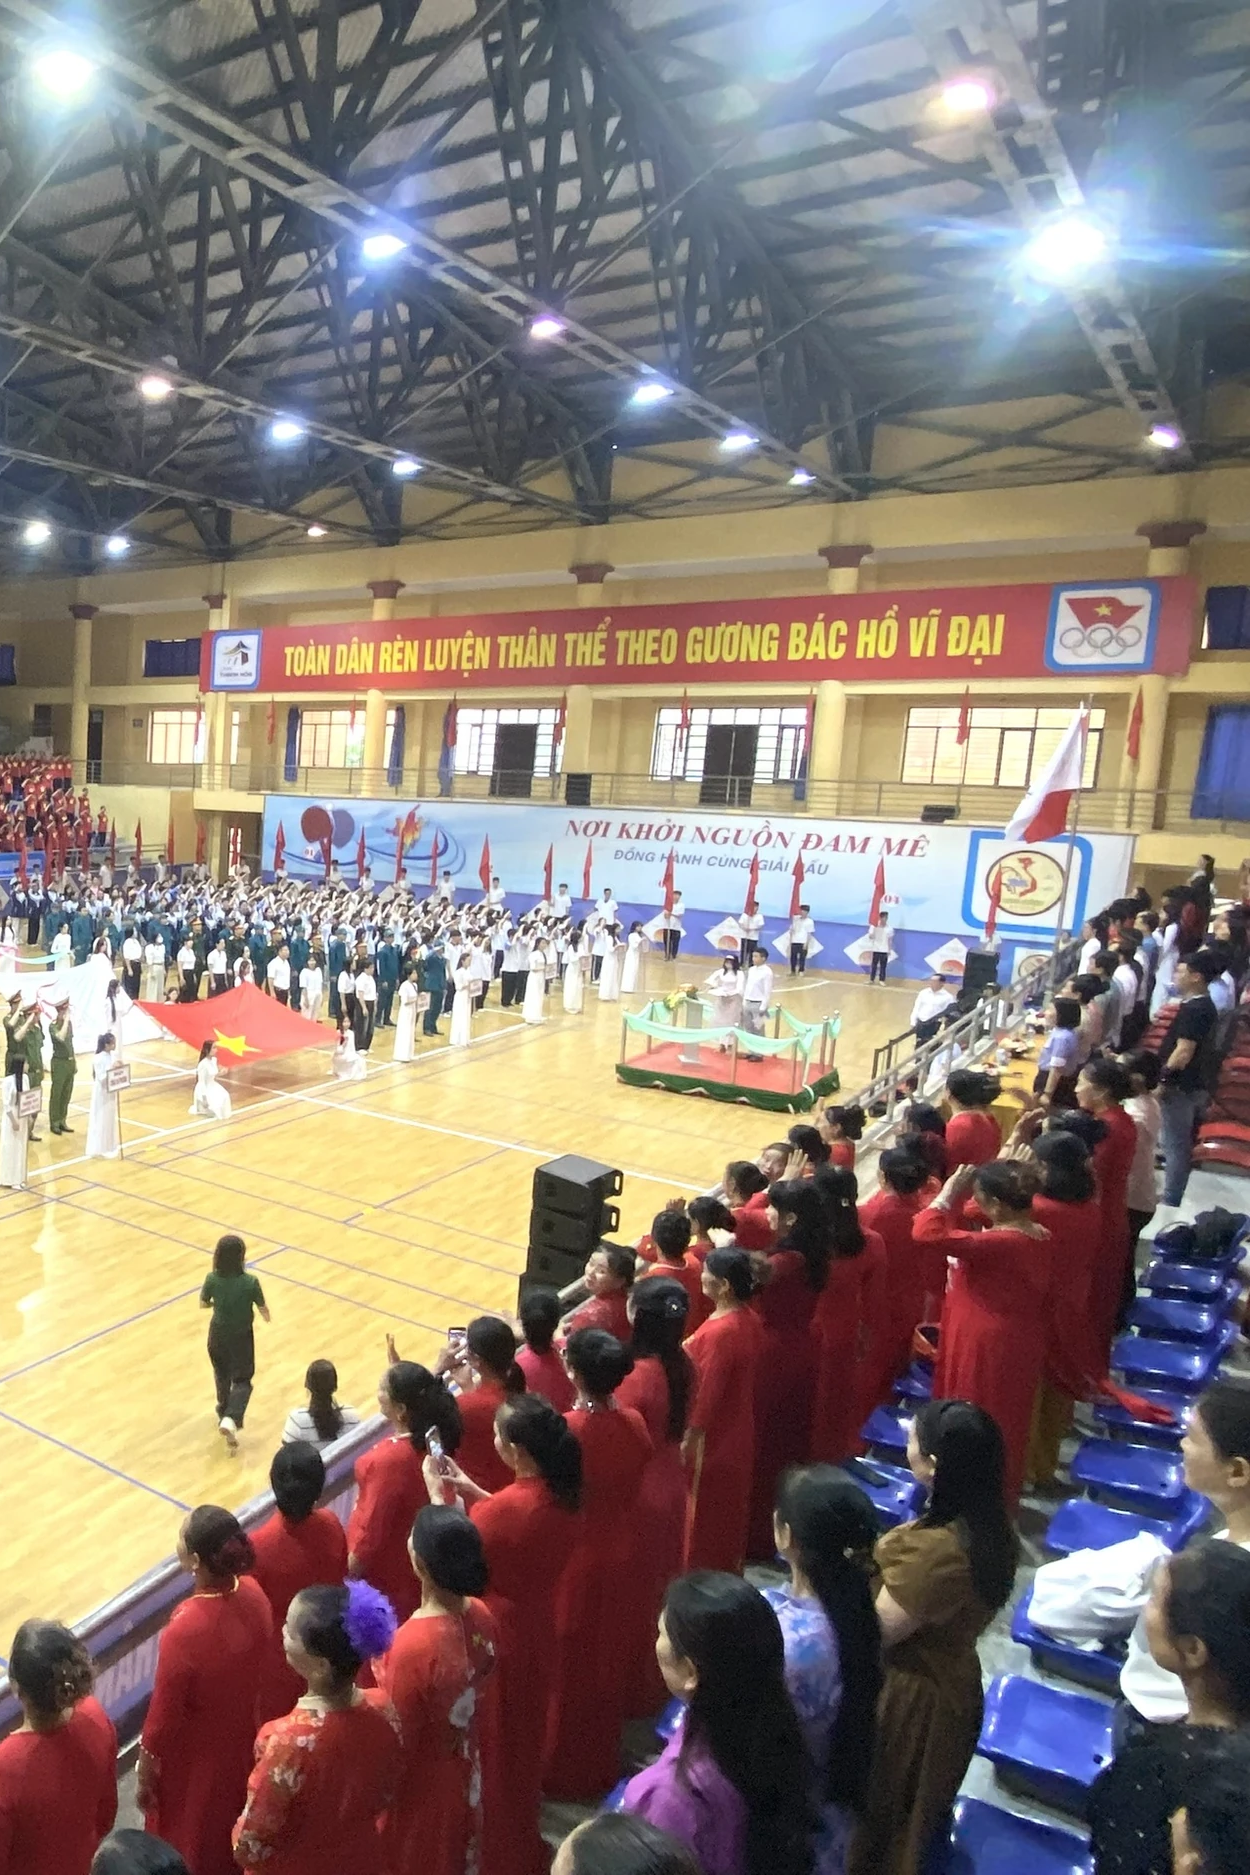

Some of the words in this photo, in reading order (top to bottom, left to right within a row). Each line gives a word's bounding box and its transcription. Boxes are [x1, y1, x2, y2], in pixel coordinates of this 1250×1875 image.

[284, 639, 331, 677] TOÀN
[335, 637, 374, 676] DÂN
[379, 634, 419, 674] RÈN
[423, 630, 491, 677] LUYỆN
[497, 626, 557, 669] THÂN
[564, 616, 612, 667] THỂ
[615, 628, 678, 666] THEO
[686, 621, 780, 664] GƯƠNG
[787, 613, 848, 661] BÁC
[855, 604, 899, 659] HỒ
[909, 608, 942, 658] VĨ
[946, 614, 1005, 665] ĐẠI
[565, 820, 612, 838] NƠI
[616, 818, 687, 842] KHỞI
[690, 820, 796, 849] NGUỒN
[800, 832, 874, 854] ĐAM
[878, 834, 930, 858] MÊ
[804, 858, 829, 875] ẤU
